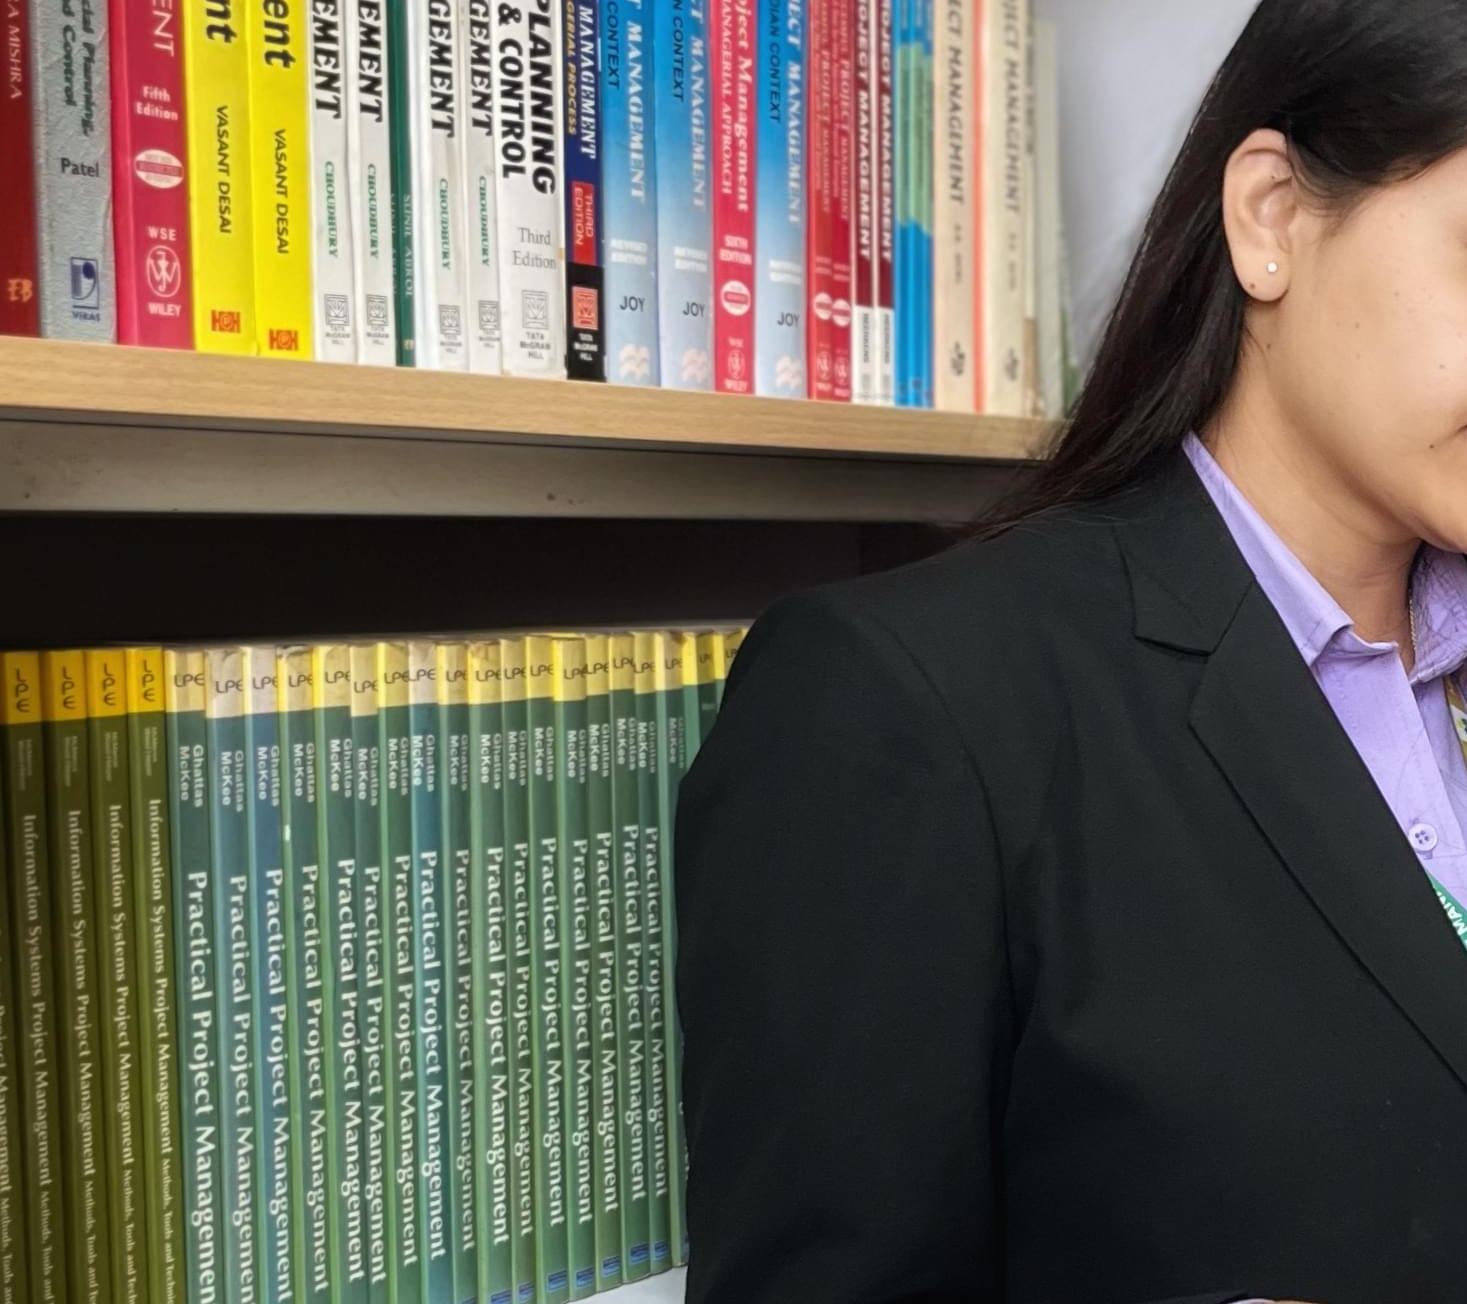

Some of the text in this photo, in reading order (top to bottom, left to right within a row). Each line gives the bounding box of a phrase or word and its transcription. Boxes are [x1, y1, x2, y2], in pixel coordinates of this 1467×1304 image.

[498, 4, 522, 26] &
[606, 7, 619, 90] CONTEXT
[136, 102, 179, 121] Edition
[143, 86, 171, 102] Fifth
[499, 38, 526, 179] CONTROL
[578, 5, 597, 159] MANAGEMENT
[627, 20, 647, 202] MANAGEMENT
[60, 157, 100, 177] Patel
[216, 105, 233, 234] VASANT DESAI
[273, 129, 290, 255] VASANT DESAI
[148, 226, 177, 241] WSE
[512, 250, 556, 270] Edition
[518, 228, 551, 245] Third
[148, 301, 181, 317] WILEY
[619, 297, 646, 312] JOY
[179, 746, 189, 801] McKee
[257, 746, 267, 801] McKee
[412, 736, 422, 786] McKee
[149, 799, 172, 1153] Information Systems Project Management
[188, 872, 213, 1000] Practical
[189, 1010, 214, 1116] Project
[420, 851, 446, 1261] Practical Project Management
[486, 847, 509, 1246] Practical Project Management
[596, 832, 618, 1212] Practical Project Management
[266, 869, 294, 1303] Practical Project Management
